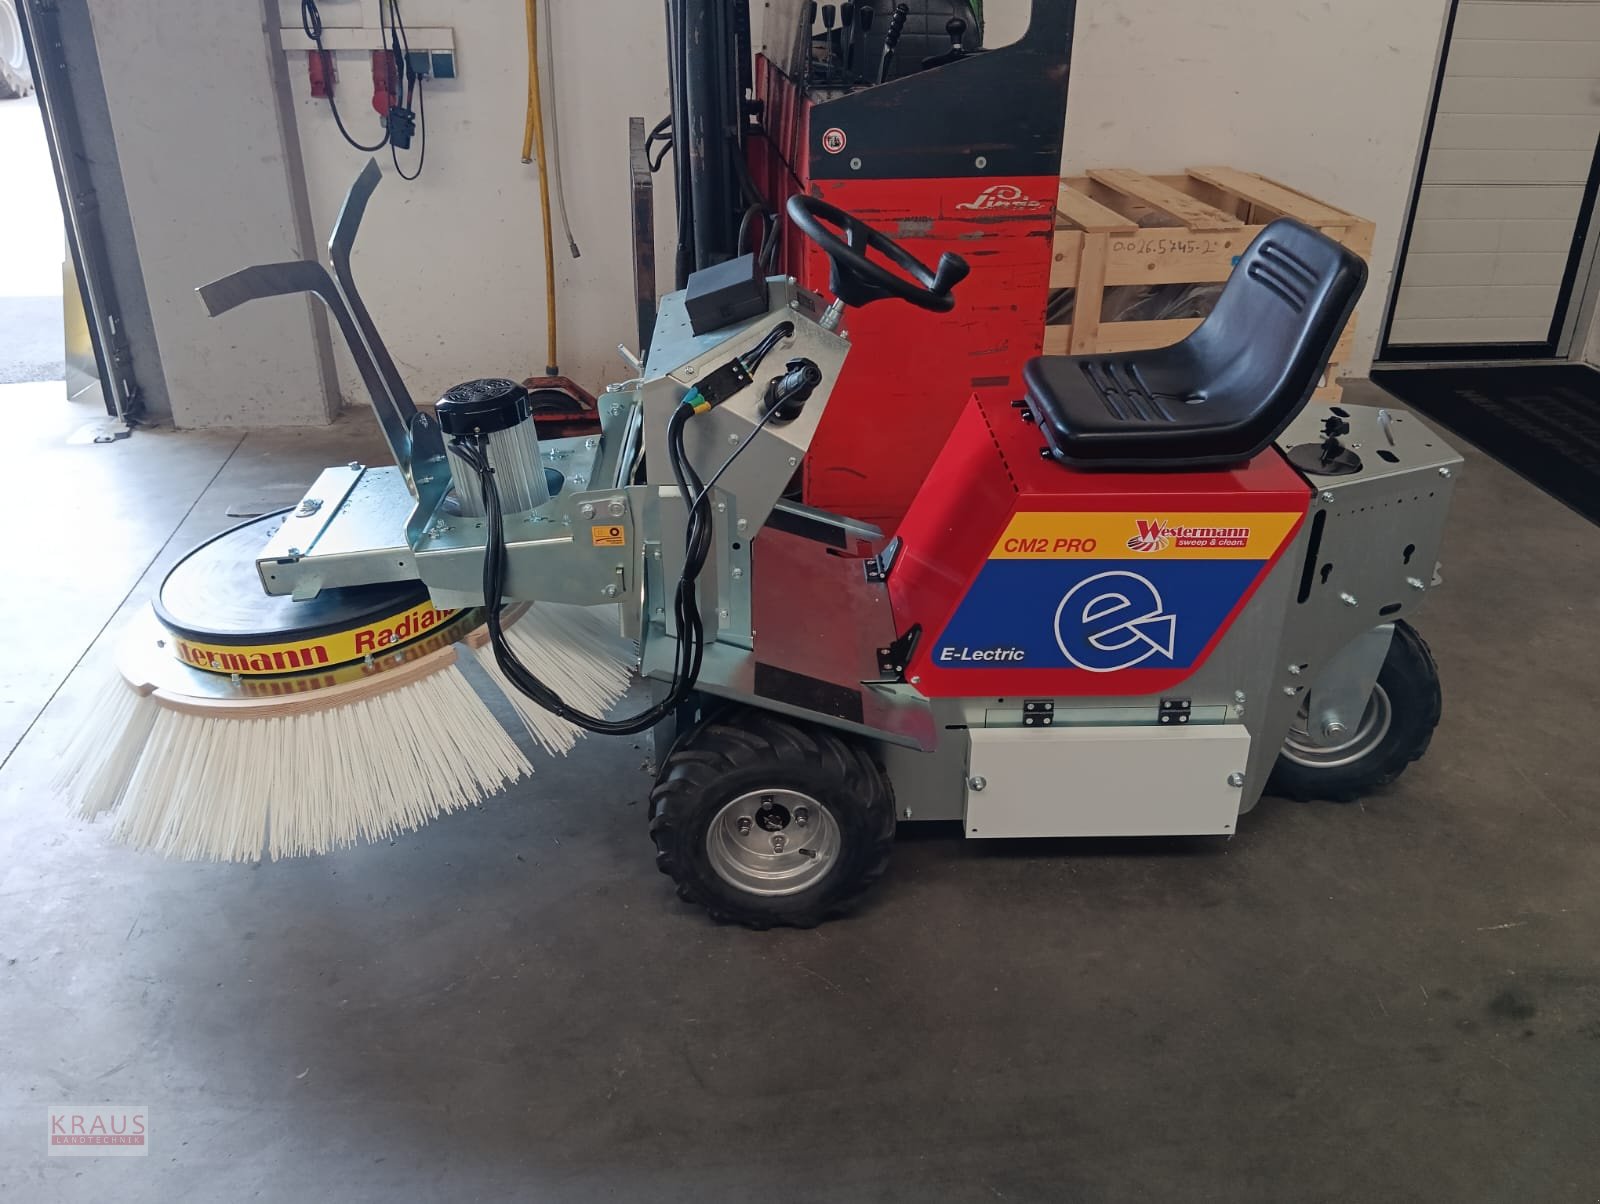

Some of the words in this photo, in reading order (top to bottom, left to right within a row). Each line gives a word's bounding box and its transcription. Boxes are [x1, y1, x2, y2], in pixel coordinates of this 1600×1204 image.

[1135, 518, 1250, 541] Westermann
[1004, 537, 1049, 553] CM2
[1052, 537, 1097, 553] PRO
[1218, 538, 1245, 546] clean.
[176, 640, 329, 671] termann
[940, 647, 1025, 661] E-Lectric
